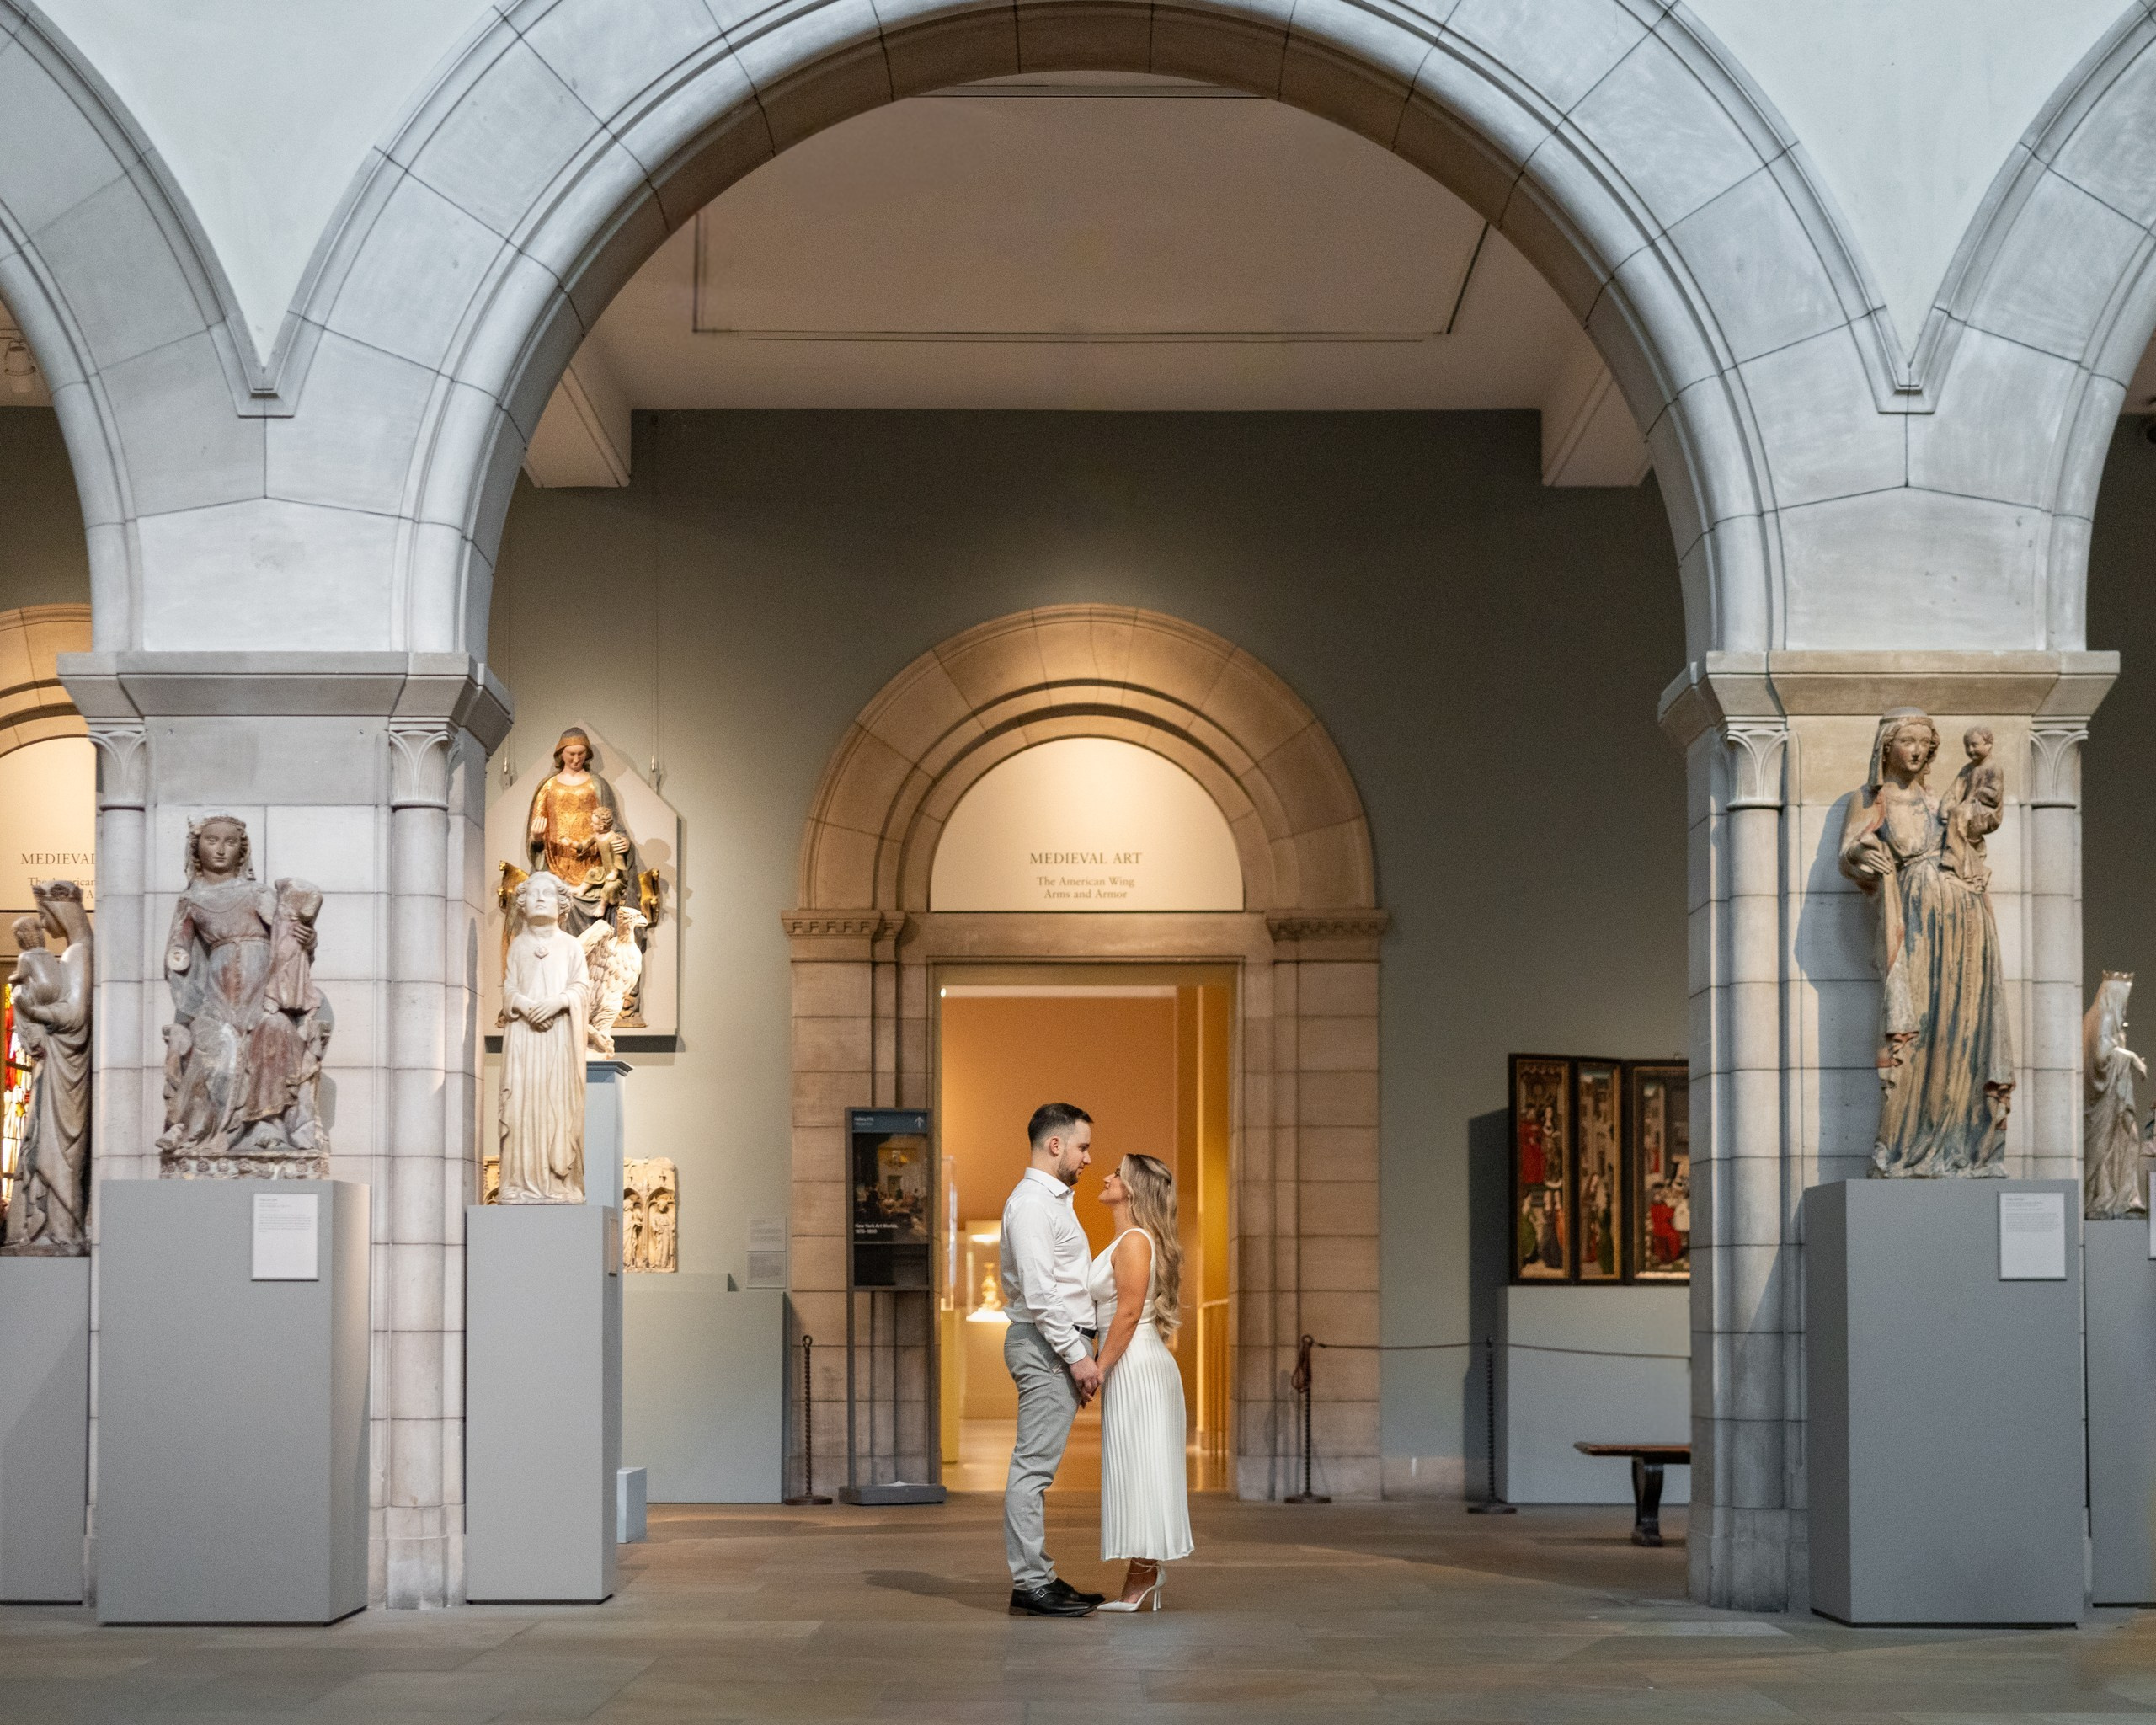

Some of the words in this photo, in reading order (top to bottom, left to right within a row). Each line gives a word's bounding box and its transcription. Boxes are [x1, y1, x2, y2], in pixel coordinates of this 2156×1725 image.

[1029, 852, 1107, 864] MEDIEVAL
[1113, 852, 1143, 864] ART
[1037, 876, 1056, 886] The
[1059, 876, 1106, 886] American
[1108, 876, 1135, 888] Wing
[1043, 889, 1070, 899] Arms
[1073, 889, 1092, 899] and
[1095, 889, 1128, 899] Armor
